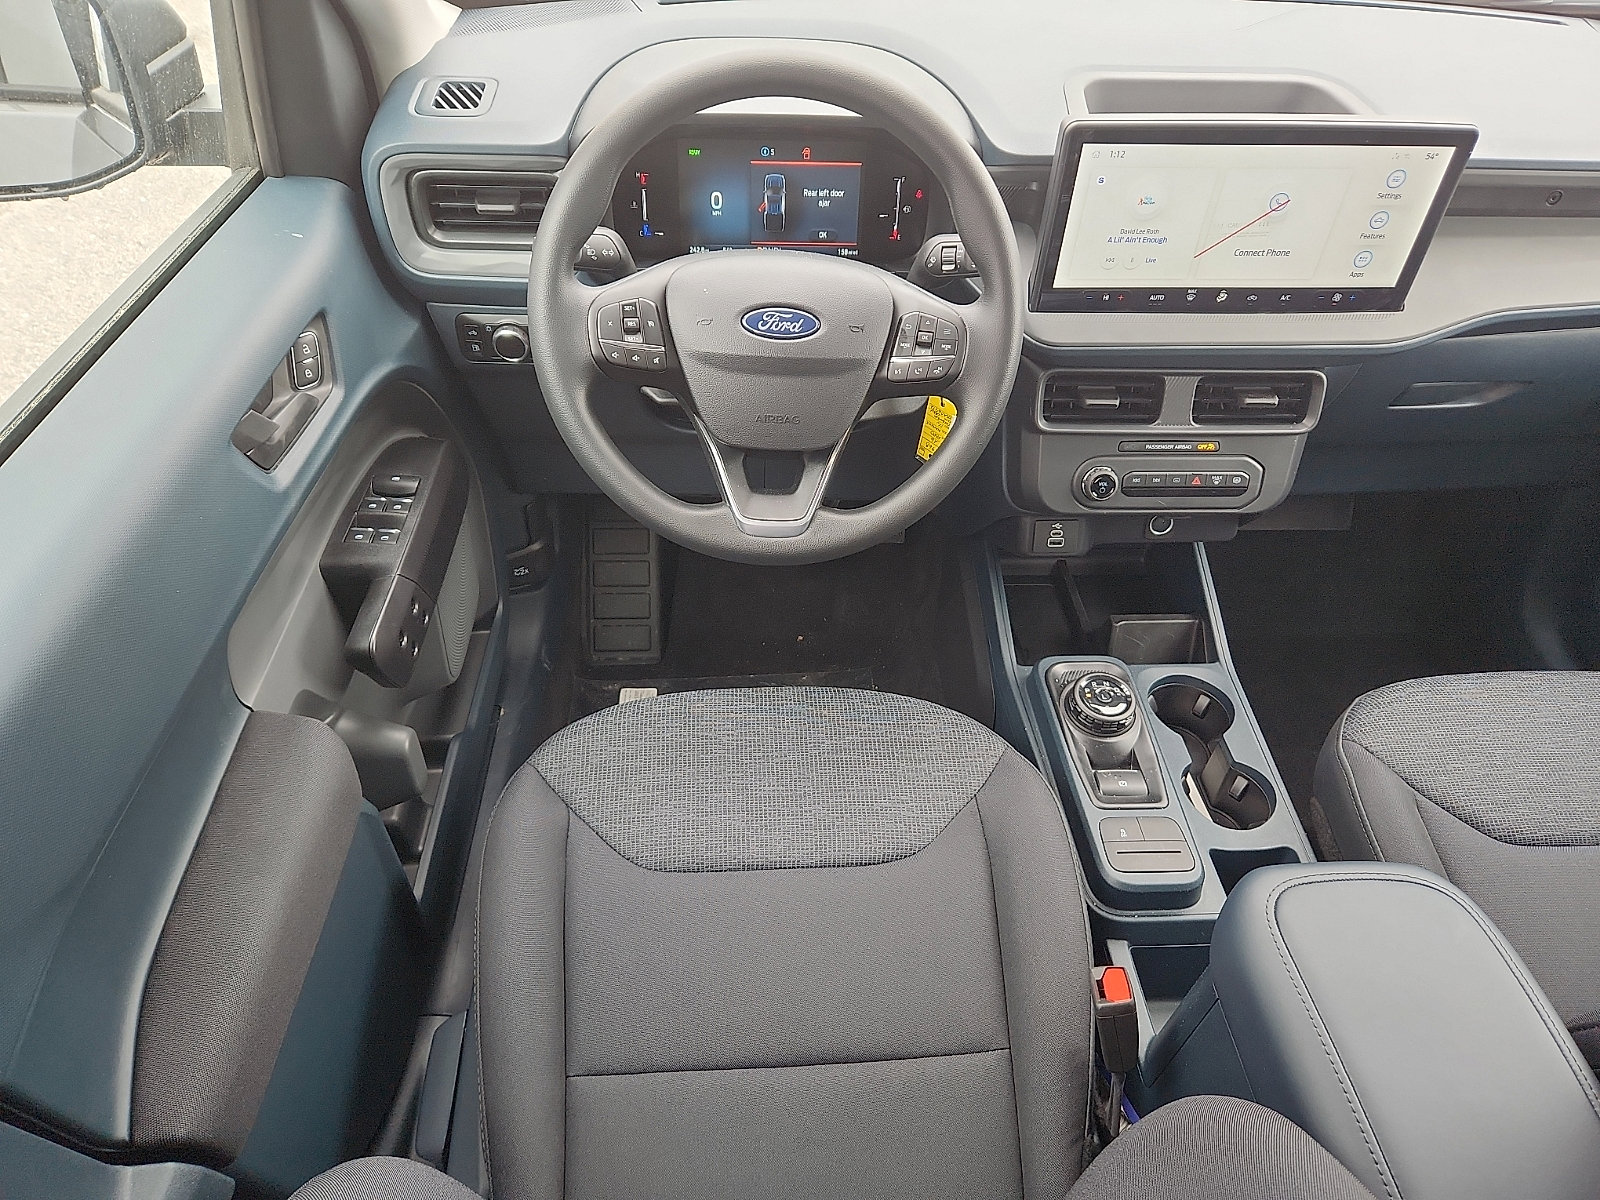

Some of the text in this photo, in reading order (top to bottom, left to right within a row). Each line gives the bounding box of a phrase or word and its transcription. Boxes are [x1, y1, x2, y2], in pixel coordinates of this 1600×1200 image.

[1109, 150, 1126, 159] 1:12
[803, 188, 845, 198] Rear left door
[1376, 192, 1403, 200] Settings
[710, 191, 723, 210] 0
[818, 199, 831, 208] ajar
[818, 231, 828, 239] OK
[1359, 232, 1386, 240] Features
[1142, 236, 1168, 245] Enough
[1233, 248, 1291, 257] Connect Phone
[758, 311, 804, 333] Ford
[755, 413, 801, 424] AIRBAG
